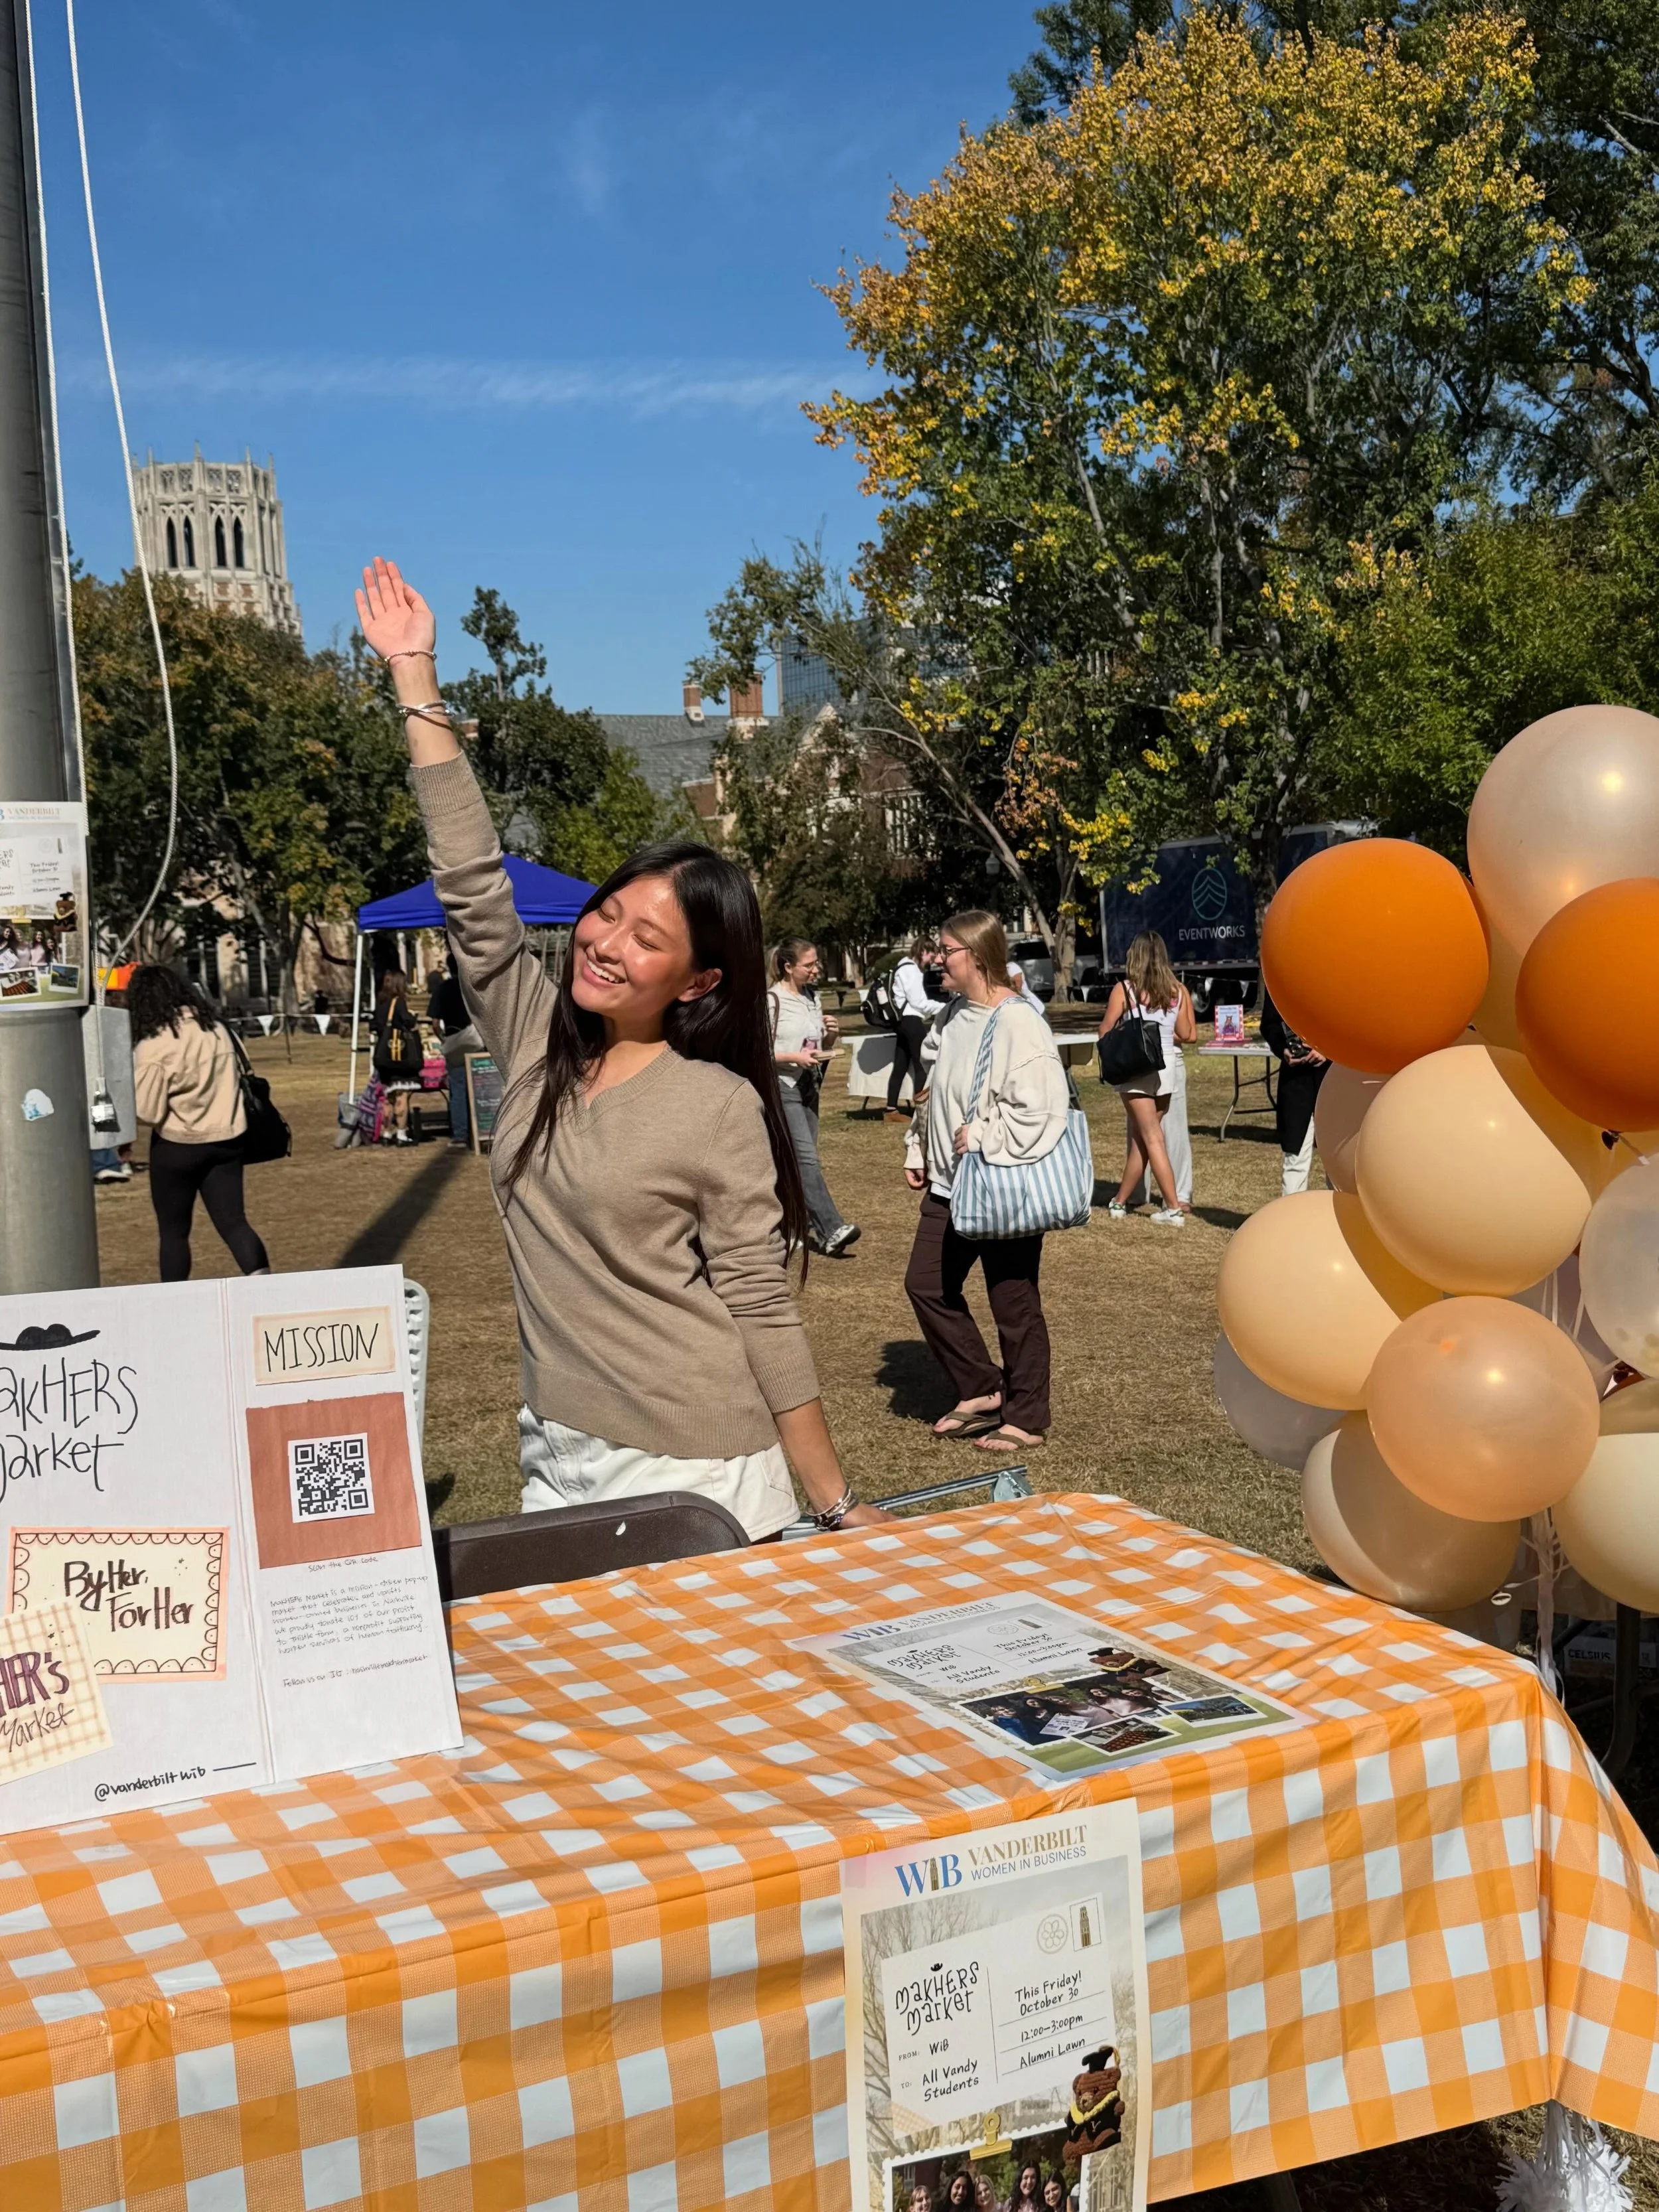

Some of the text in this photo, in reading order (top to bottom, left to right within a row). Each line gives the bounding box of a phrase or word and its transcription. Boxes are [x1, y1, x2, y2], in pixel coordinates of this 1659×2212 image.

[1179, 925, 1246, 941] EVENTWORKS
[264, 1323, 379, 1372] MISSION
[0, 1432, 125, 1504] arket
[64, 1560, 108, 1612] By
[106, 1586, 194, 1633] For Her
[899, 1601, 995, 1627] VANDERBILT
[1004, 1640, 1040, 1651] October
[1028, 1647, 1082, 1664] Alumni Lawn
[1568, 1649, 1611, 1660] CELSIUS
[946, 1664, 992, 1680] All Vandy
[956, 1669, 1001, 1684] Students
[968, 1824, 1087, 1867] VANDERBILT
[971, 1845, 1086, 1881] WOMEN IN BUSINESS
[1015, 1969, 1082, 2003] This Friday!
[1020, 1987, 1079, 2016] October 30
[1020, 2038, 1086, 2069] Alumni Lawn
[922, 2068, 938, 2087] All
[942, 2058, 977, 2079] Vandy
[924, 2076, 979, 2102] Students
